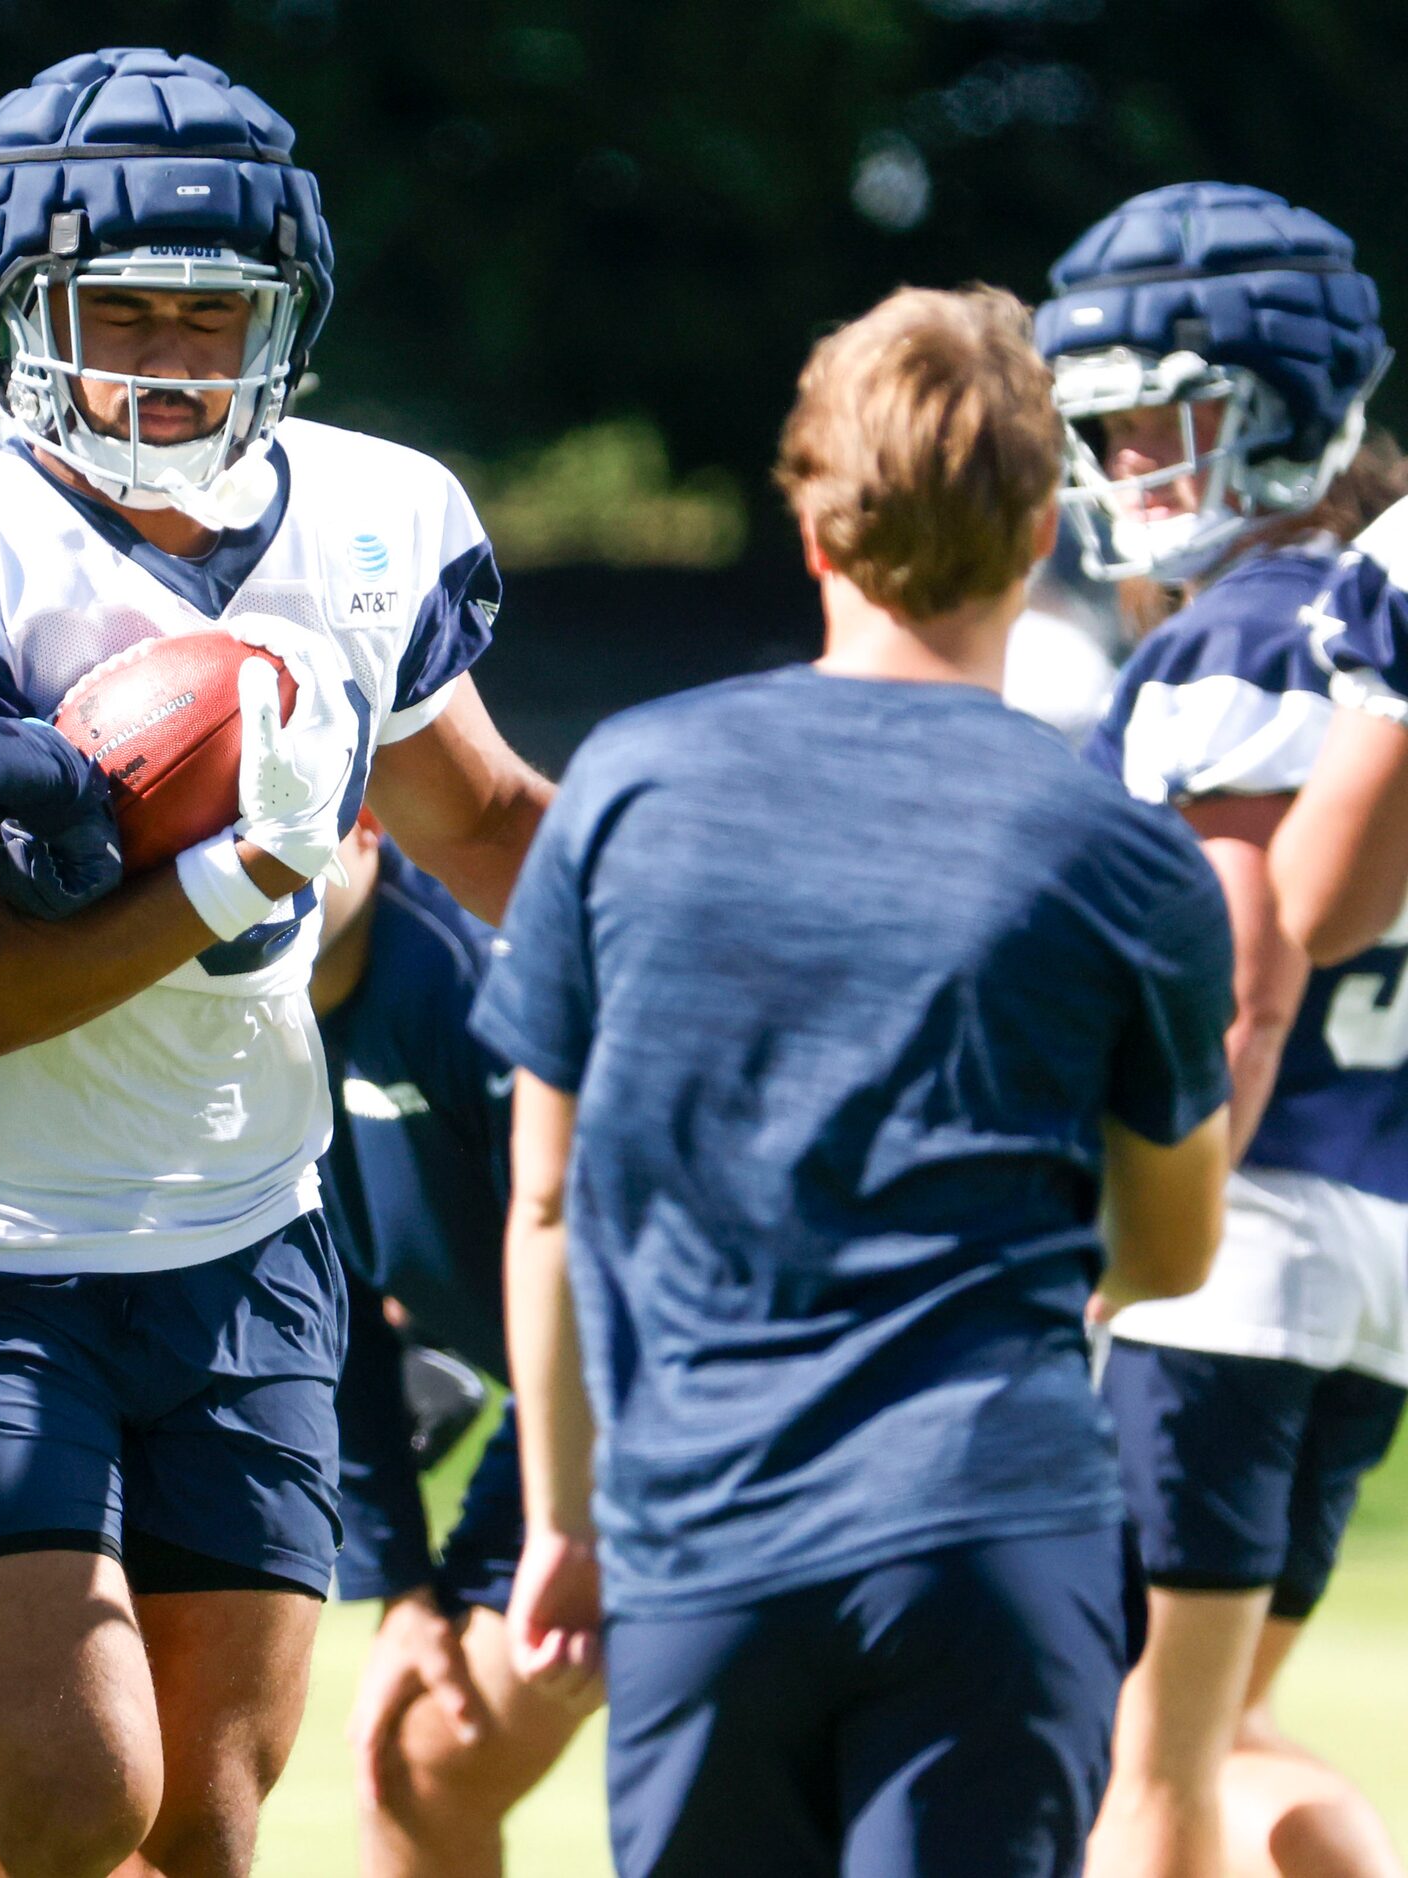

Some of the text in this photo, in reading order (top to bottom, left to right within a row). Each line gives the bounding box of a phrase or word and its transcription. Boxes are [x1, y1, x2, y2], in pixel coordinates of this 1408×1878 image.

[150, 245, 221, 258] COWBOYS
[350, 592, 397, 614] AT&T
[143, 690, 197, 727] LEAGUE
